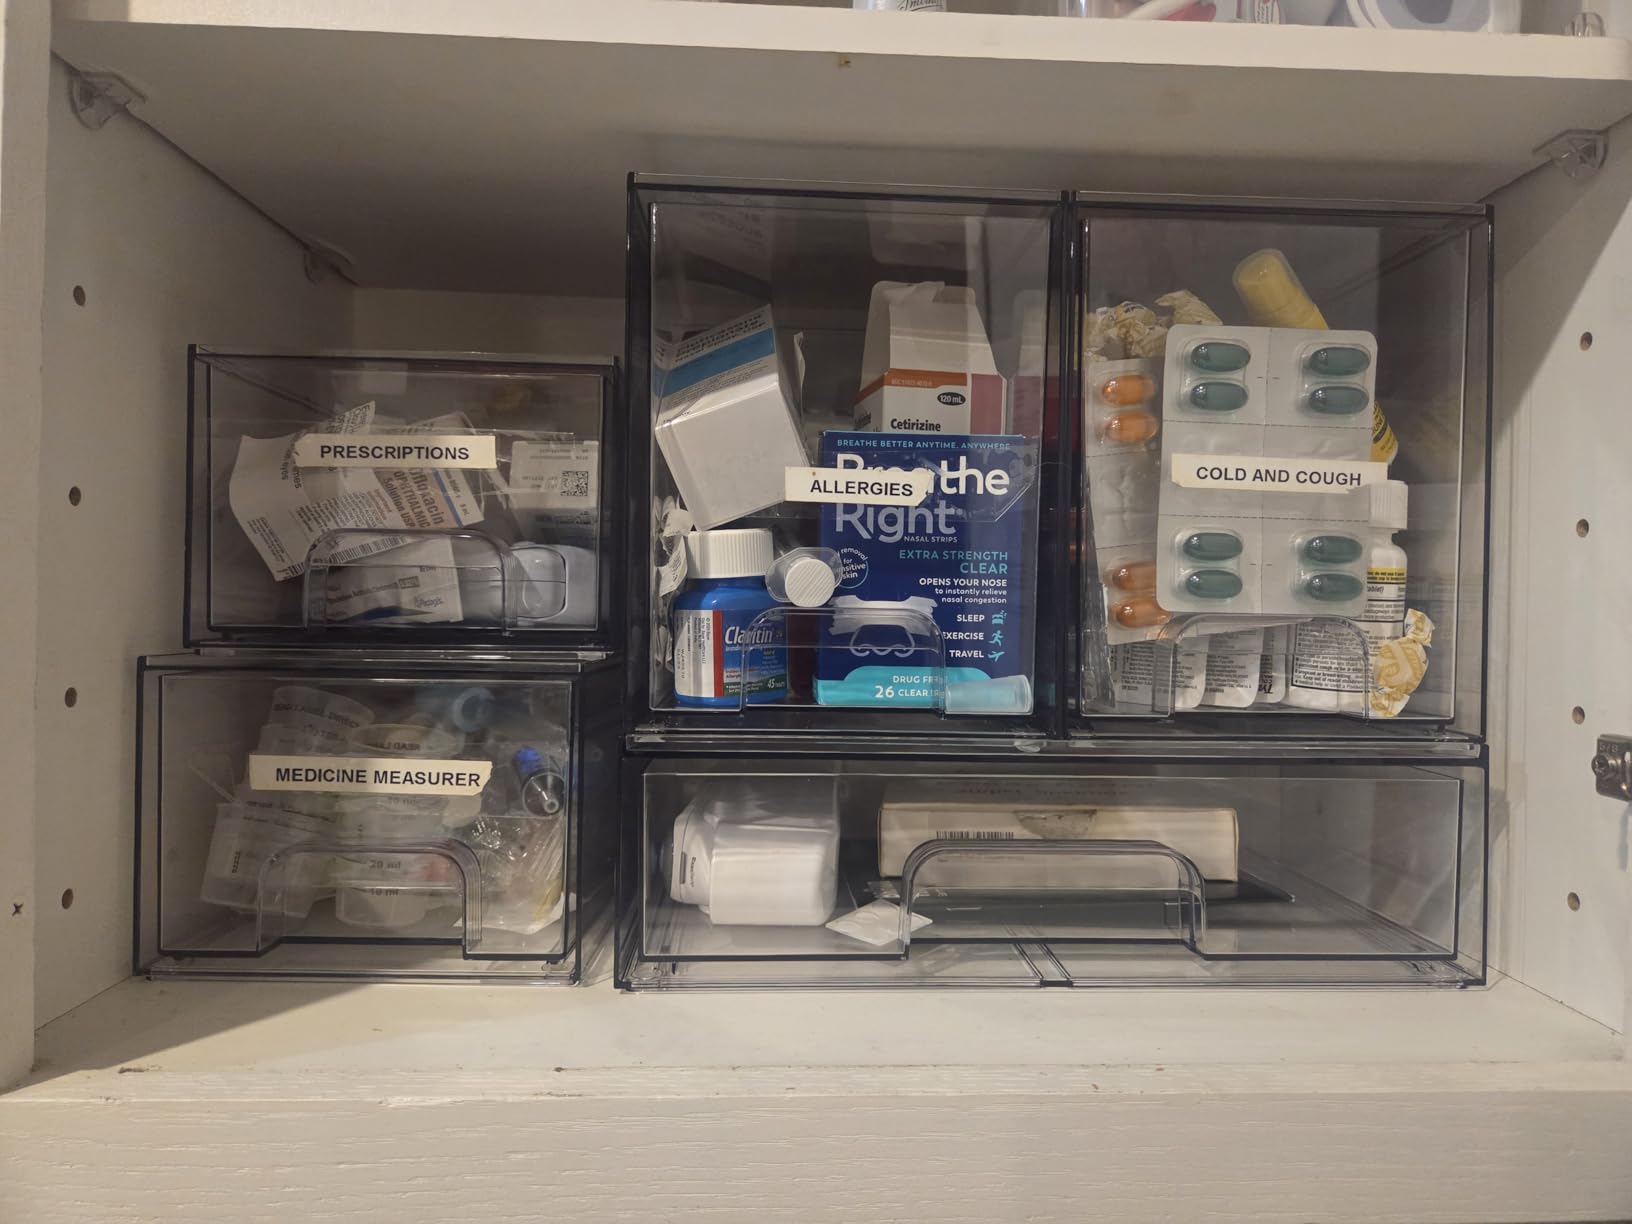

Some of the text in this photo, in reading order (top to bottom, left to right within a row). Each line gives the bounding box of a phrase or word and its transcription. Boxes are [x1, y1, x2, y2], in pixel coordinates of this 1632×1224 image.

[940, 395, 951, 403] 120
[891, 418, 941, 432] Cetirizine
[837, 439, 877, 447] BREATHE
[880, 440, 913, 448] BETTER
[320, 444, 470, 462] PRESCRIPTIONS
[836, 453, 1010, 496] Bthe
[1196, 466, 1361, 486] COLD AND COUGH
[810, 480, 913, 498] ALLERGIES
[384, 476, 406, 513] Solution
[400, 510, 416, 528] USP
[835, 499, 957, 543] Right
[904, 535, 929, 543] NASAL
[841, 547, 868, 561] removal
[899, 549, 1008, 561] EXTRA STRENGTH
[960, 562, 1008, 574] CLEAR
[842, 571, 858, 579] skin
[919, 578, 1008, 587] OPENS YOUR NOSE
[945, 588, 980, 597] instantly
[964, 597, 1007, 605] congestion
[956, 614, 985, 622] SLEEP
[724, 625, 773, 644] Claritin
[942, 631, 985, 640] EXERCISE
[949, 650, 985, 658] TRAVEL
[767, 678, 775, 689] 45
[892, 675, 921, 684] DRUG
[874, 685, 895, 698] 26
[898, 689, 928, 697] CLEAR
[275, 767, 481, 788] MEDICINE MEASURER
